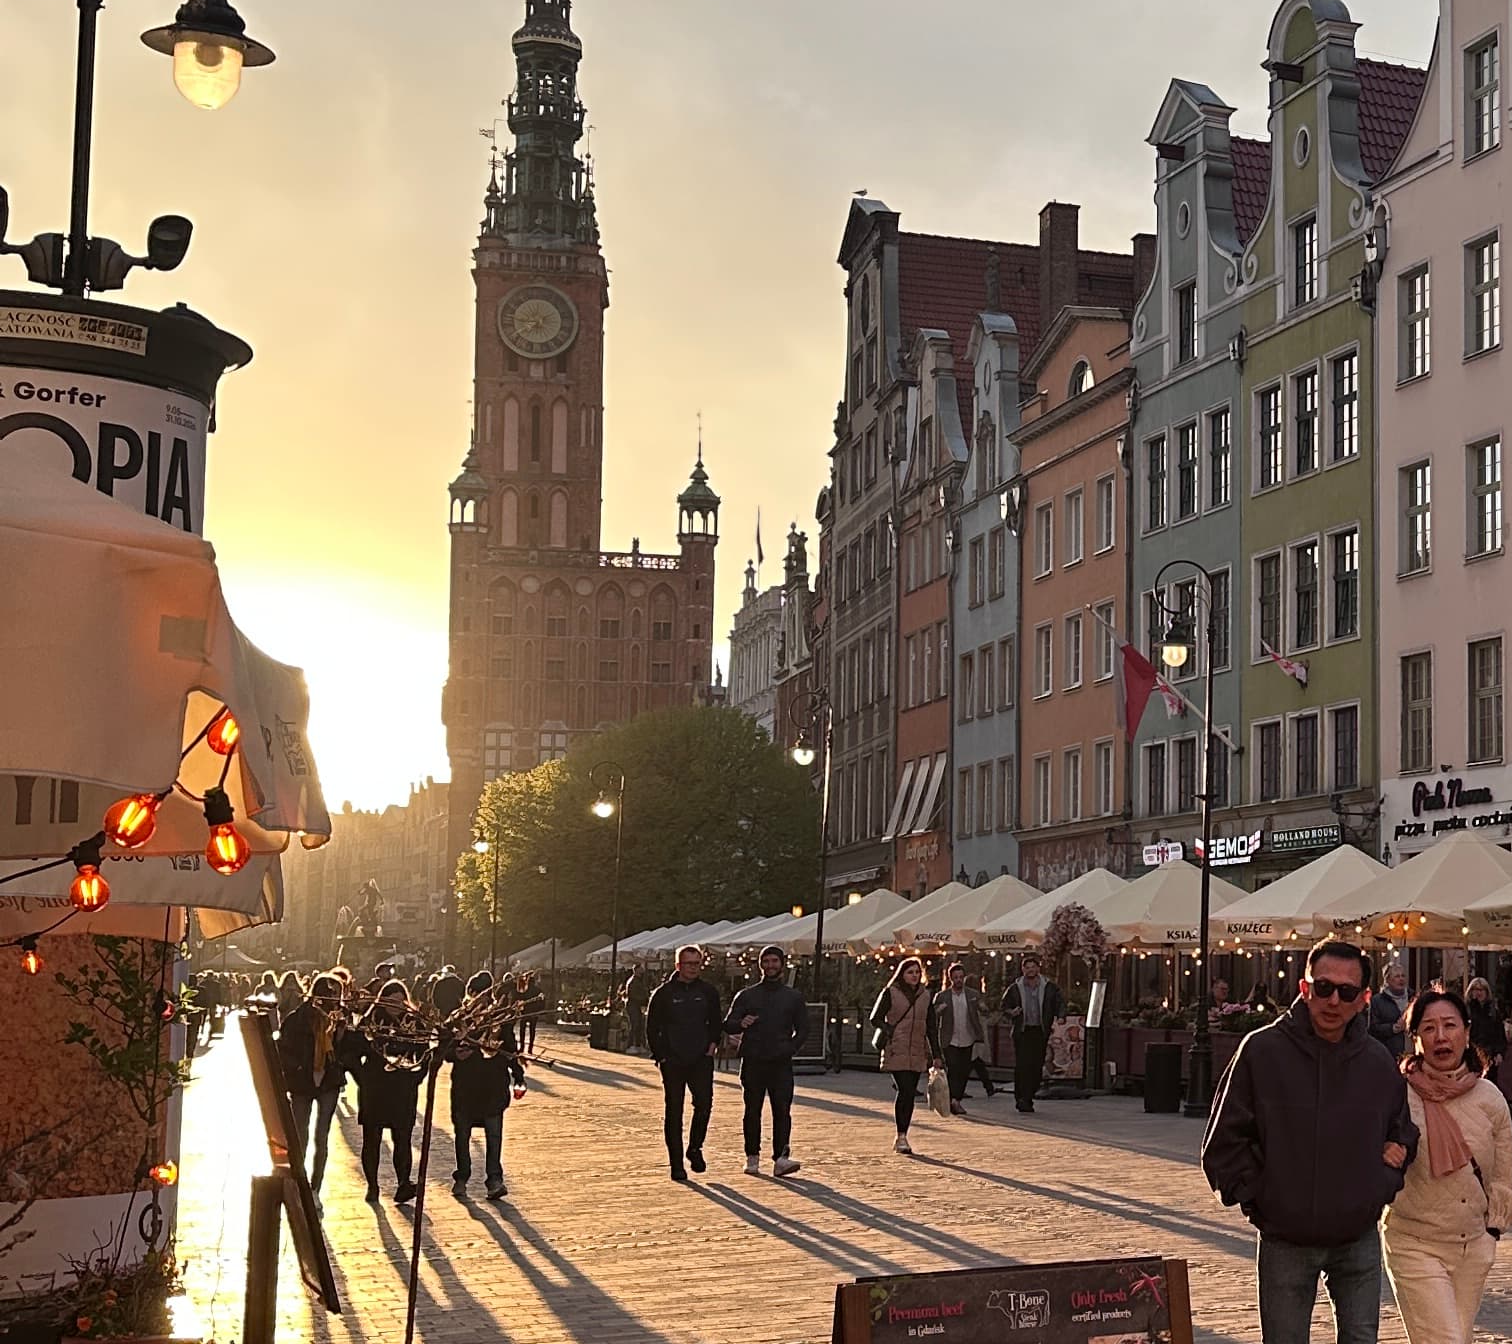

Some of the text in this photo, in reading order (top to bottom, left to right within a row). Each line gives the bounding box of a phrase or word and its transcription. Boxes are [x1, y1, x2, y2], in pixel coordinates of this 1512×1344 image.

[13, 381, 107, 408] Gorfer
[1007, 1292, 1046, 1311] T-Bone
[1071, 1288, 1128, 1309] Only fresh
[888, 1300, 967, 1324] Premium beef
